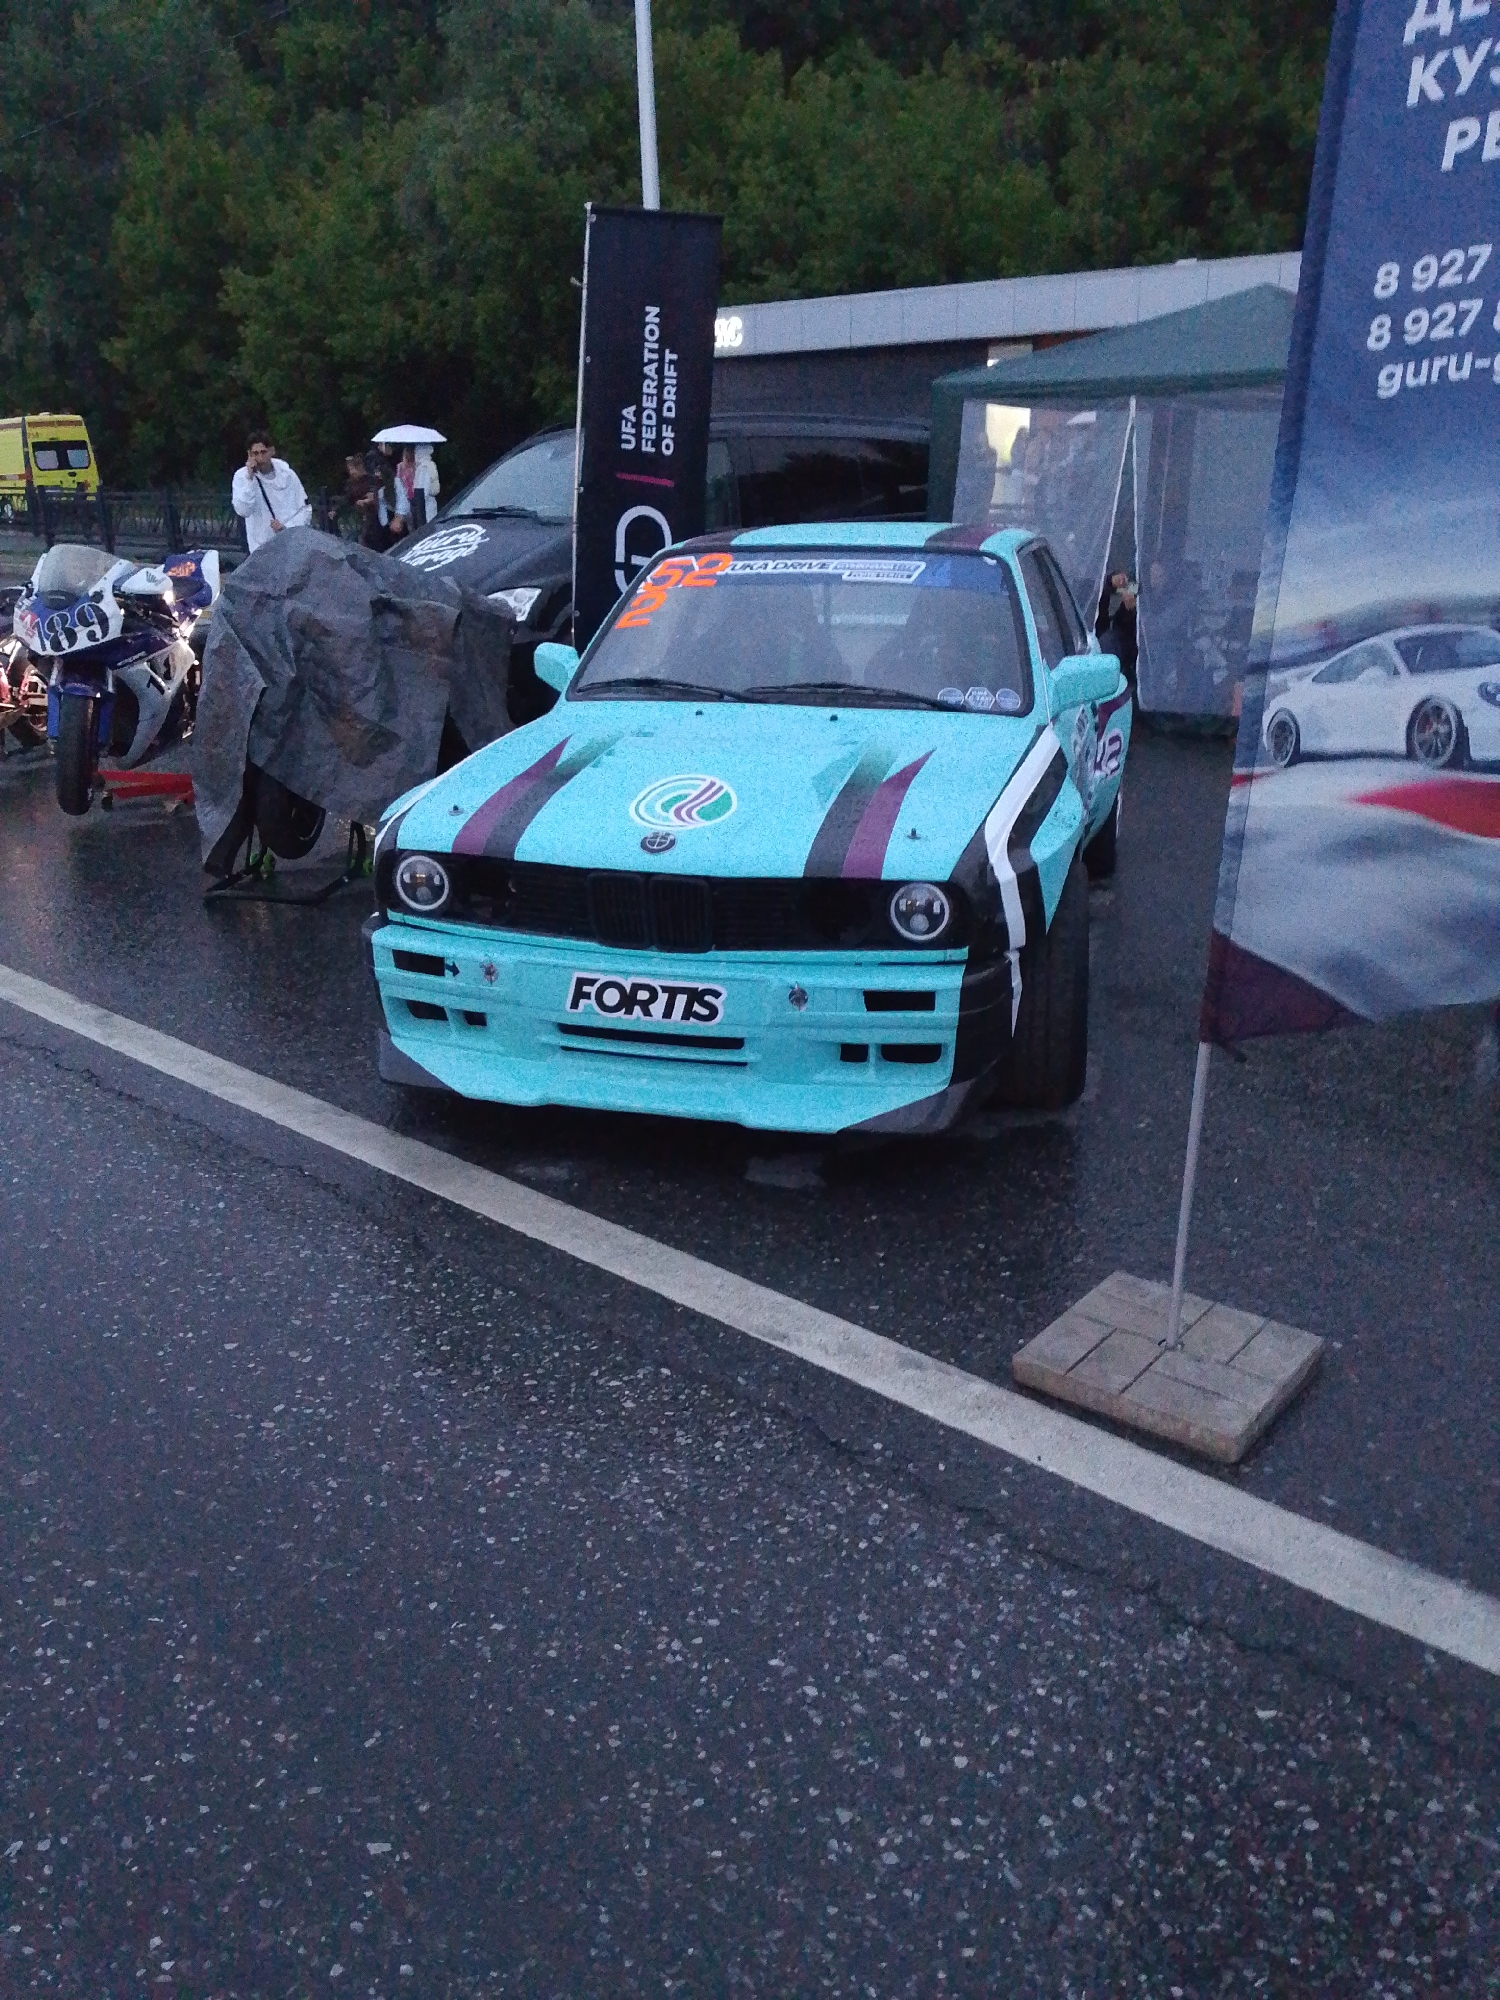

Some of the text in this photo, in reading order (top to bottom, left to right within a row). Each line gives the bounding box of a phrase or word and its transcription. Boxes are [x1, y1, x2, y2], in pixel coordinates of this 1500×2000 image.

[1373, 243, 1493, 300] 8 927
[1366, 313, 1392, 351] 8
[1403, 298, 1483, 346] 927
[641, 305, 660, 454] FEDERATION
[1376, 351, 1500, 400] guru-
[621, 404, 637, 451] UFA
[661, 348, 679, 457] OF DRIFT
[643, 553, 733, 592] 52
[771, 561, 833, 571] DRIVE
[31, 603, 110, 653] 189
[569, 976, 723, 1022] FORTIS
